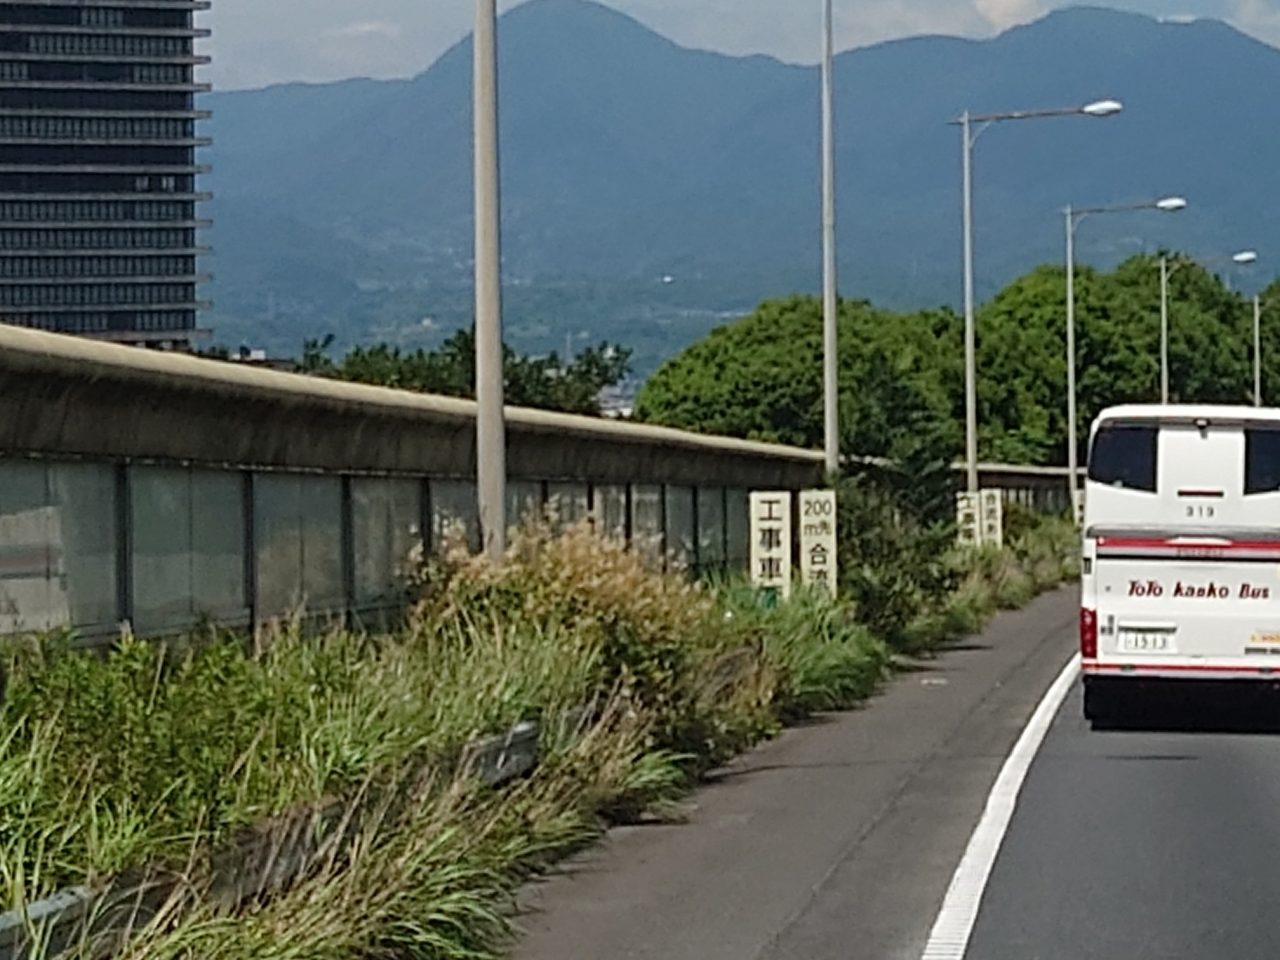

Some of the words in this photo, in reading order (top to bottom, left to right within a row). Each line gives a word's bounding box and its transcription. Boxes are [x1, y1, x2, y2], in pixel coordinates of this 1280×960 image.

[803, 499, 832, 516] 200
[758, 499, 784, 588] 工事車
[1239, 582, 1270, 599] Bus
